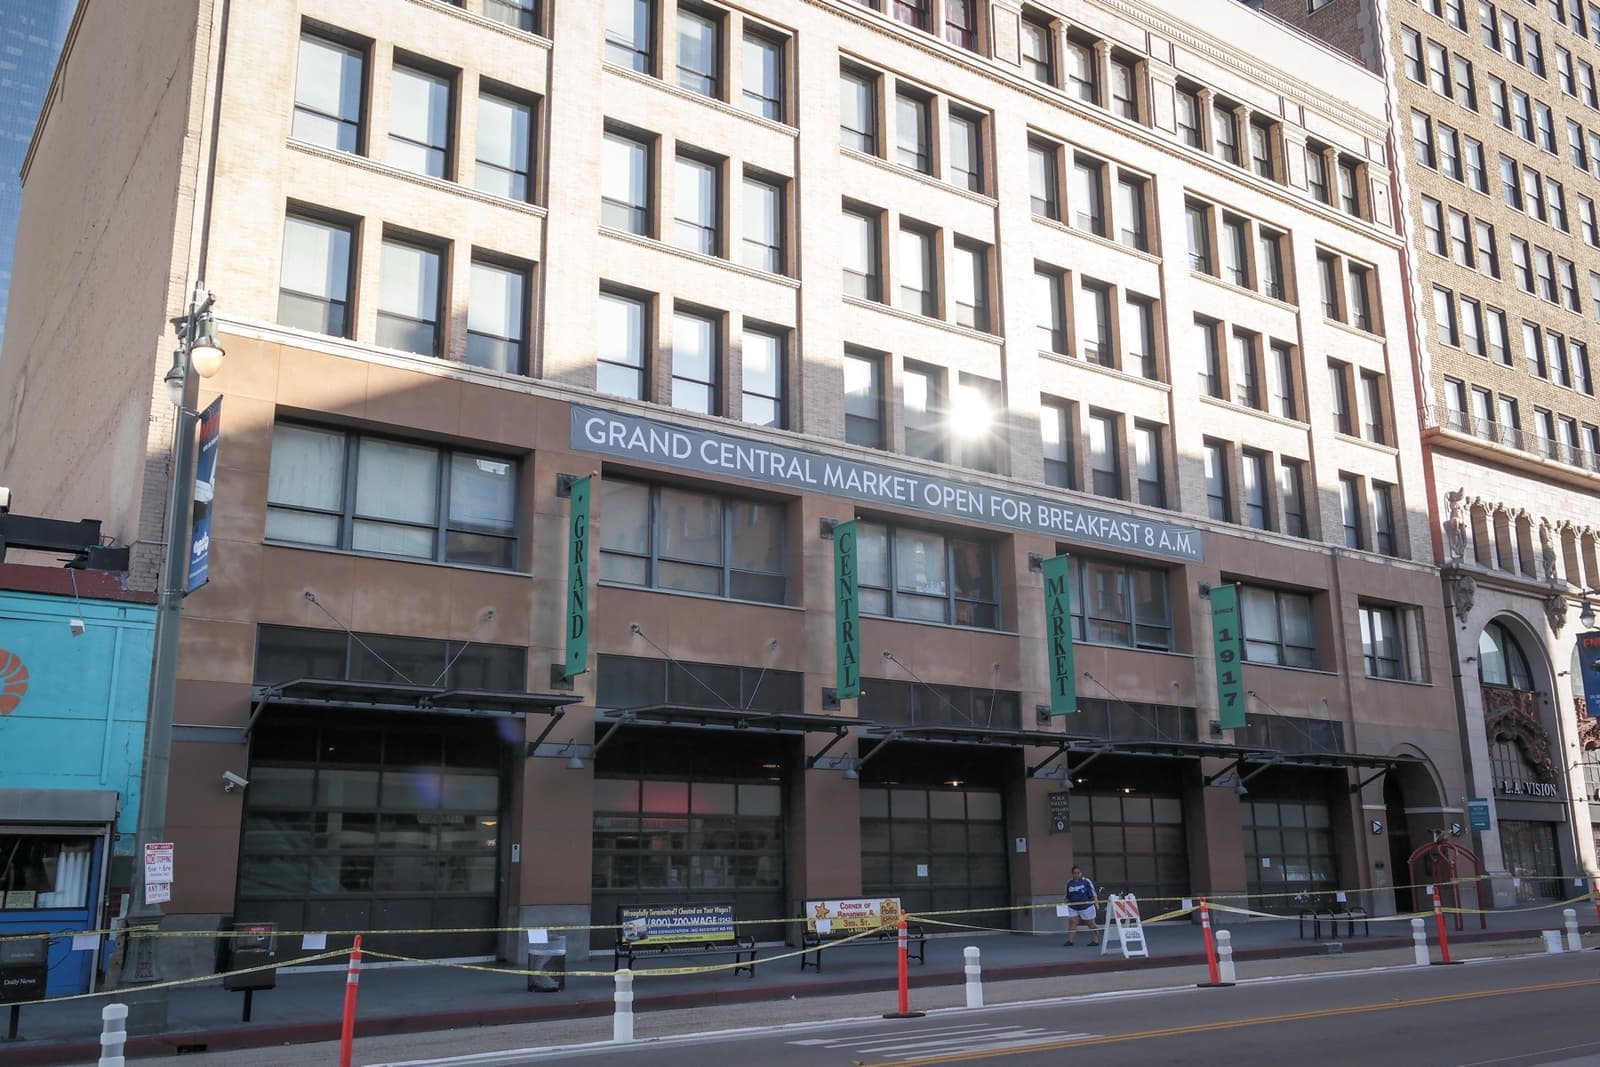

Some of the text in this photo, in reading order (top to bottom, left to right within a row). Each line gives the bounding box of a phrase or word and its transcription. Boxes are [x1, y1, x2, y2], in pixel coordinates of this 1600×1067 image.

[584, 417, 1197, 555] GRAND CENTRAL MARKET OPEN FOR BREAKFAST 8 A.M.
[572, 514, 585, 640] GRAND
[839, 532, 857, 689] CENTRAL
[1047, 574, 1068, 697] MARKET
[1219, 628, 1238, 707] 1917
[1504, 780, 1557, 797] L.A. VISION
[839, 902, 862, 910] CORNER
[4, 978, 19, 986] Daily
